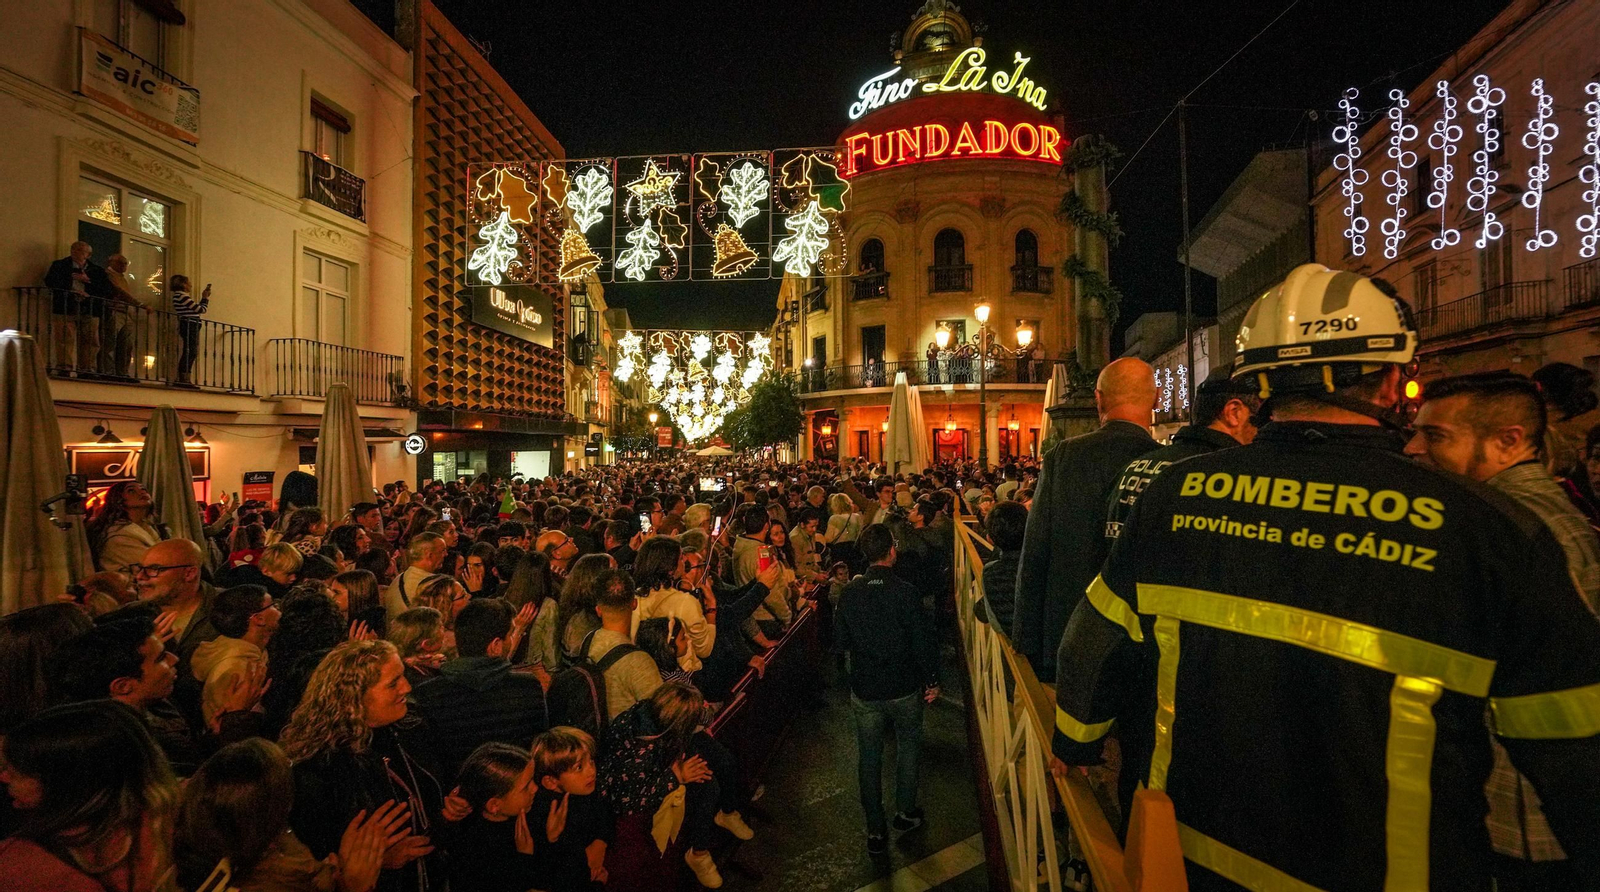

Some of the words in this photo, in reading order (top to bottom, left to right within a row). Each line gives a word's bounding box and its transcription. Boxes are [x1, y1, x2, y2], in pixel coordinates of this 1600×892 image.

[113, 66, 156, 95] aic
[848, 66, 919, 120] Fino
[922, 47, 988, 92] La
[845, 120, 1061, 175] FUNDADOR
[1299, 317, 1357, 335] 7290
[1279, 347, 1309, 356] MSA
[1124, 459, 1173, 475] POLIC
[1118, 475, 1151, 493] LOC
[1180, 472, 1445, 530] BOMBEROS
[1171, 513, 1283, 544] provincia
[1290, 527, 1326, 549] de
[1334, 532, 1438, 572] CÁDIZ
